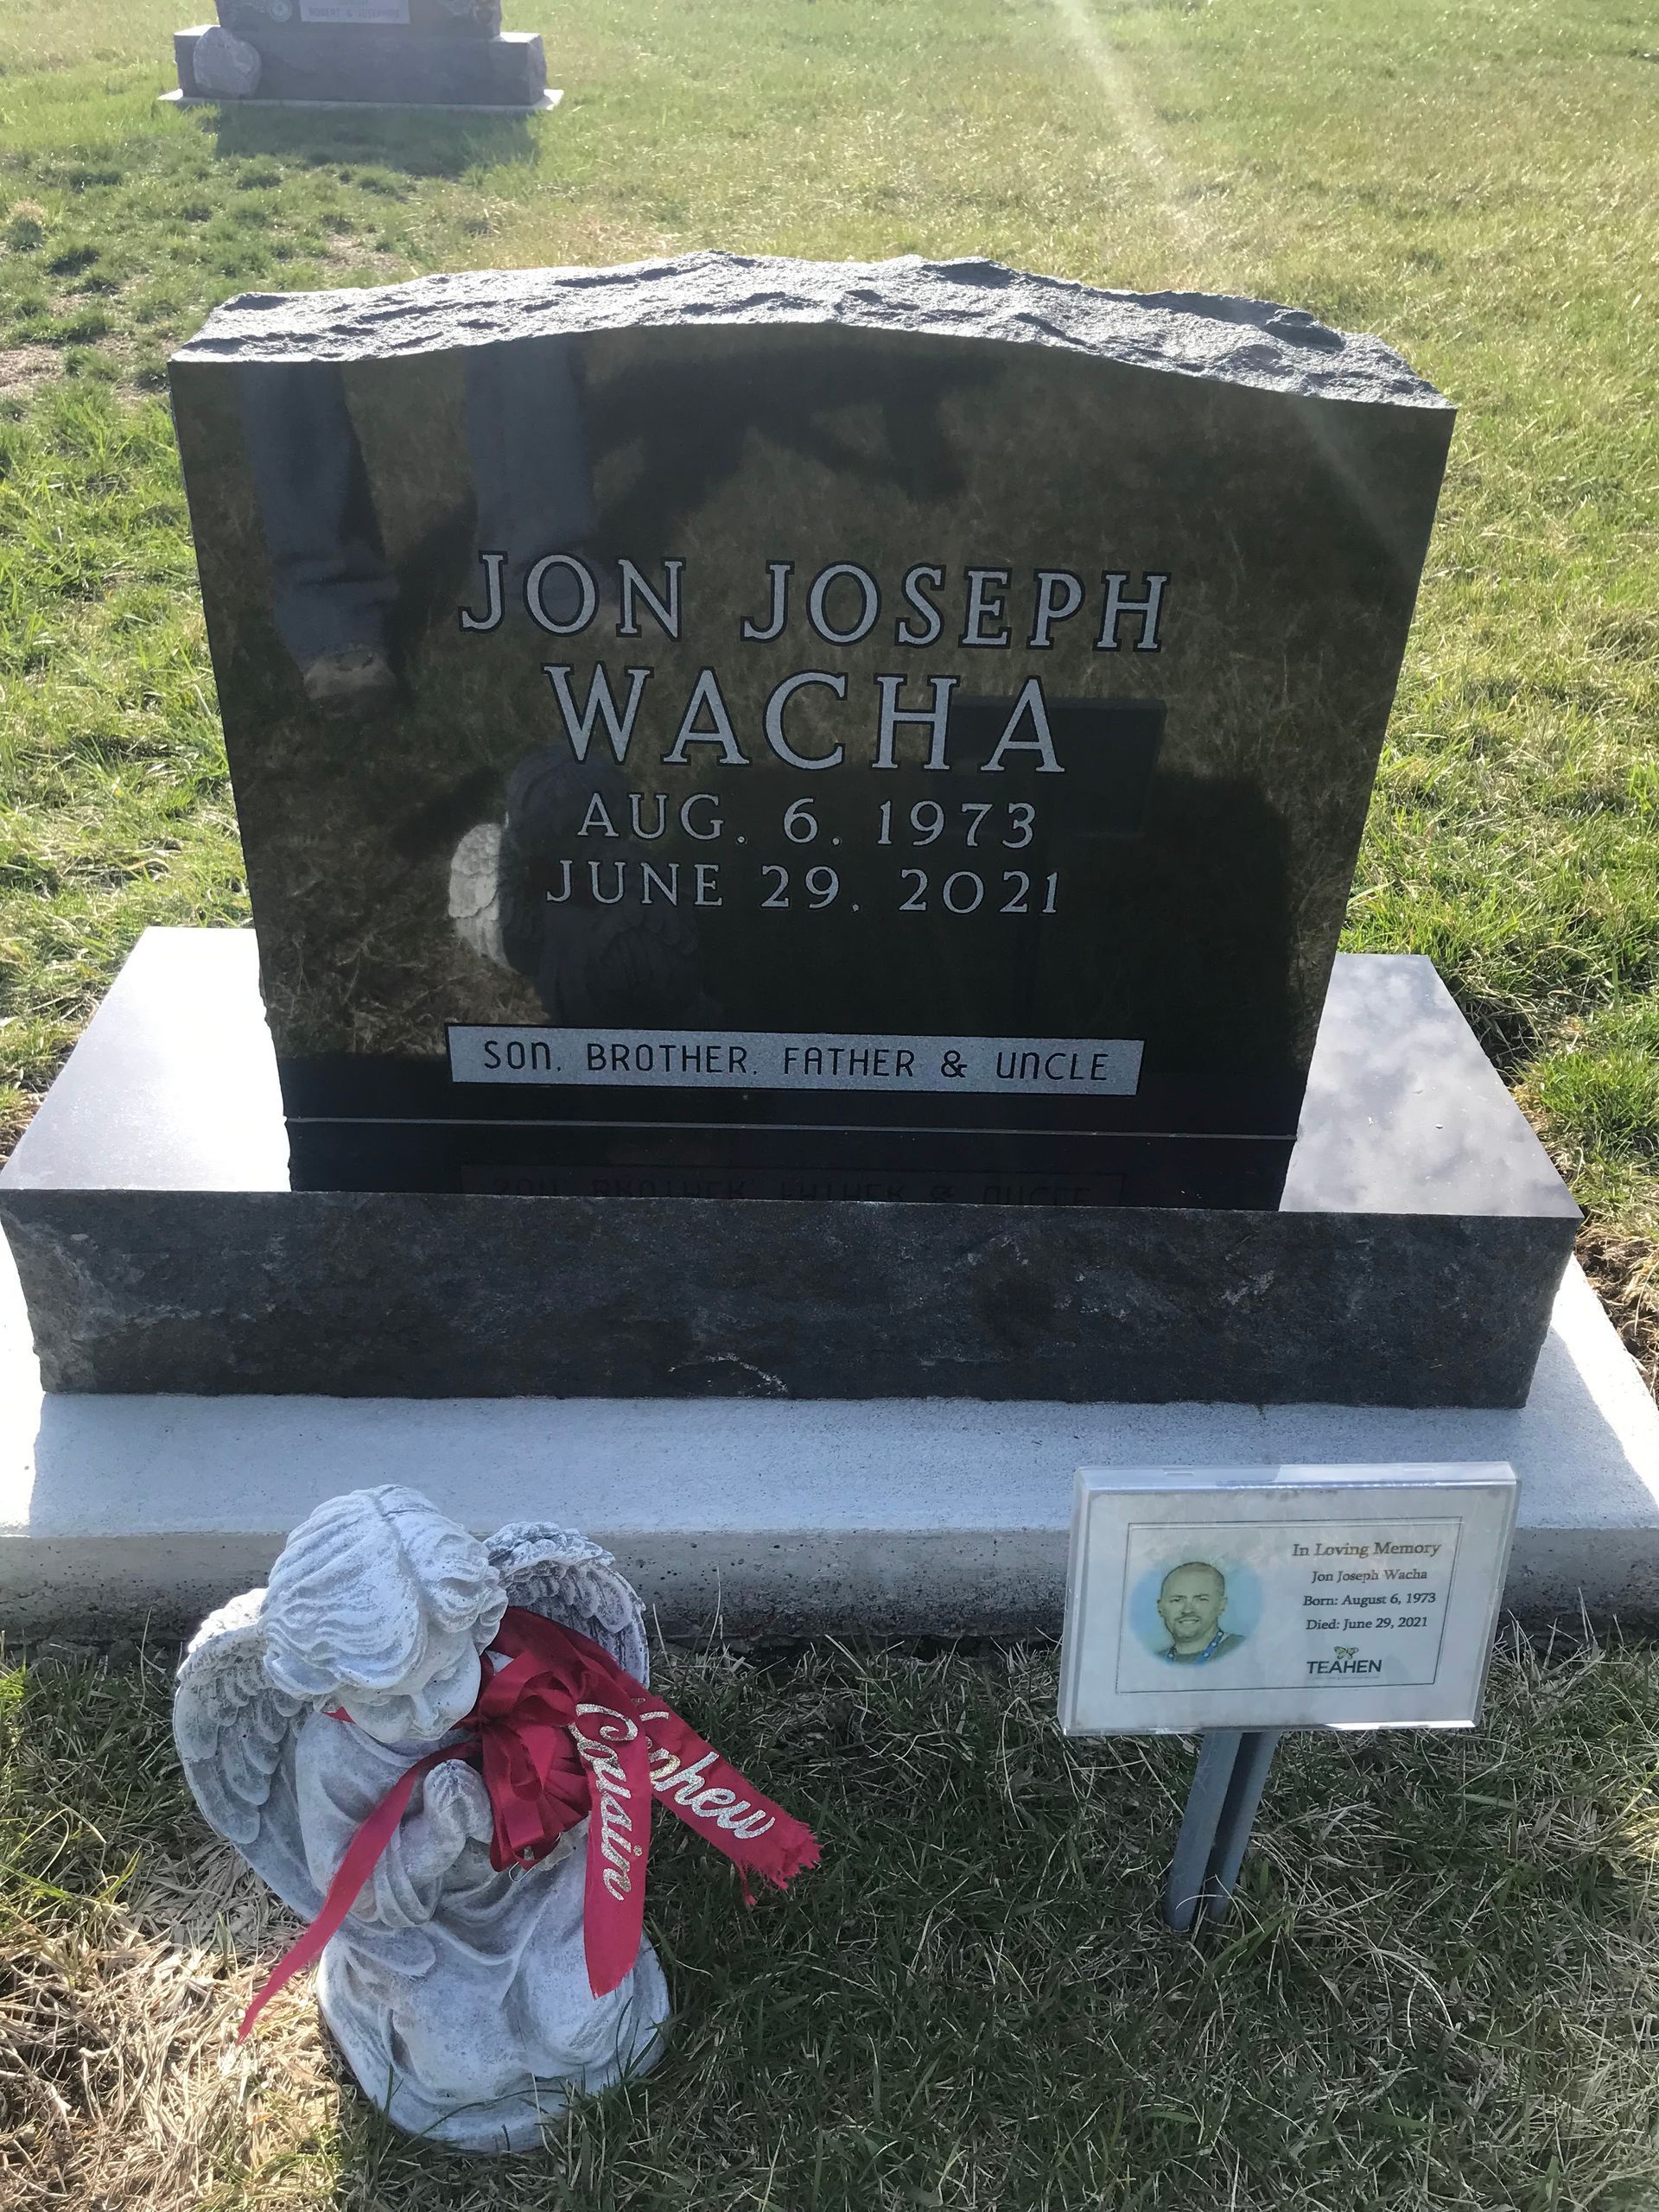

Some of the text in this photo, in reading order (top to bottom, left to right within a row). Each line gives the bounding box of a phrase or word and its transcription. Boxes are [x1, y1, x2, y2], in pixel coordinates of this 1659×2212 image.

[461, 551, 1168, 652] JON JOSEPH
[543, 663, 1066, 774] WACHA
[576, 792, 747, 843] AUG.
[877, 800, 1037, 849] 1973
[547, 860, 723, 907] JUNE
[899, 868, 1058, 914] 2021
[784, 1046, 915, 1077] FATHER
[940, 1050, 968, 1078] &
[996, 1051, 1109, 1081] UNCLE
[1293, 1541, 1442, 1559] In Loving Memory
[1312, 1568, 1428, 1584] Jon Joseph Wacha
[1303, 1592, 1437, 1608] Born: August 6, 1973
[1306, 1616, 1428, 1631] Died: June 29, 2021
[1306, 1659, 1383, 1675] TEAHEN
[568, 1703, 643, 1902] Cousin
